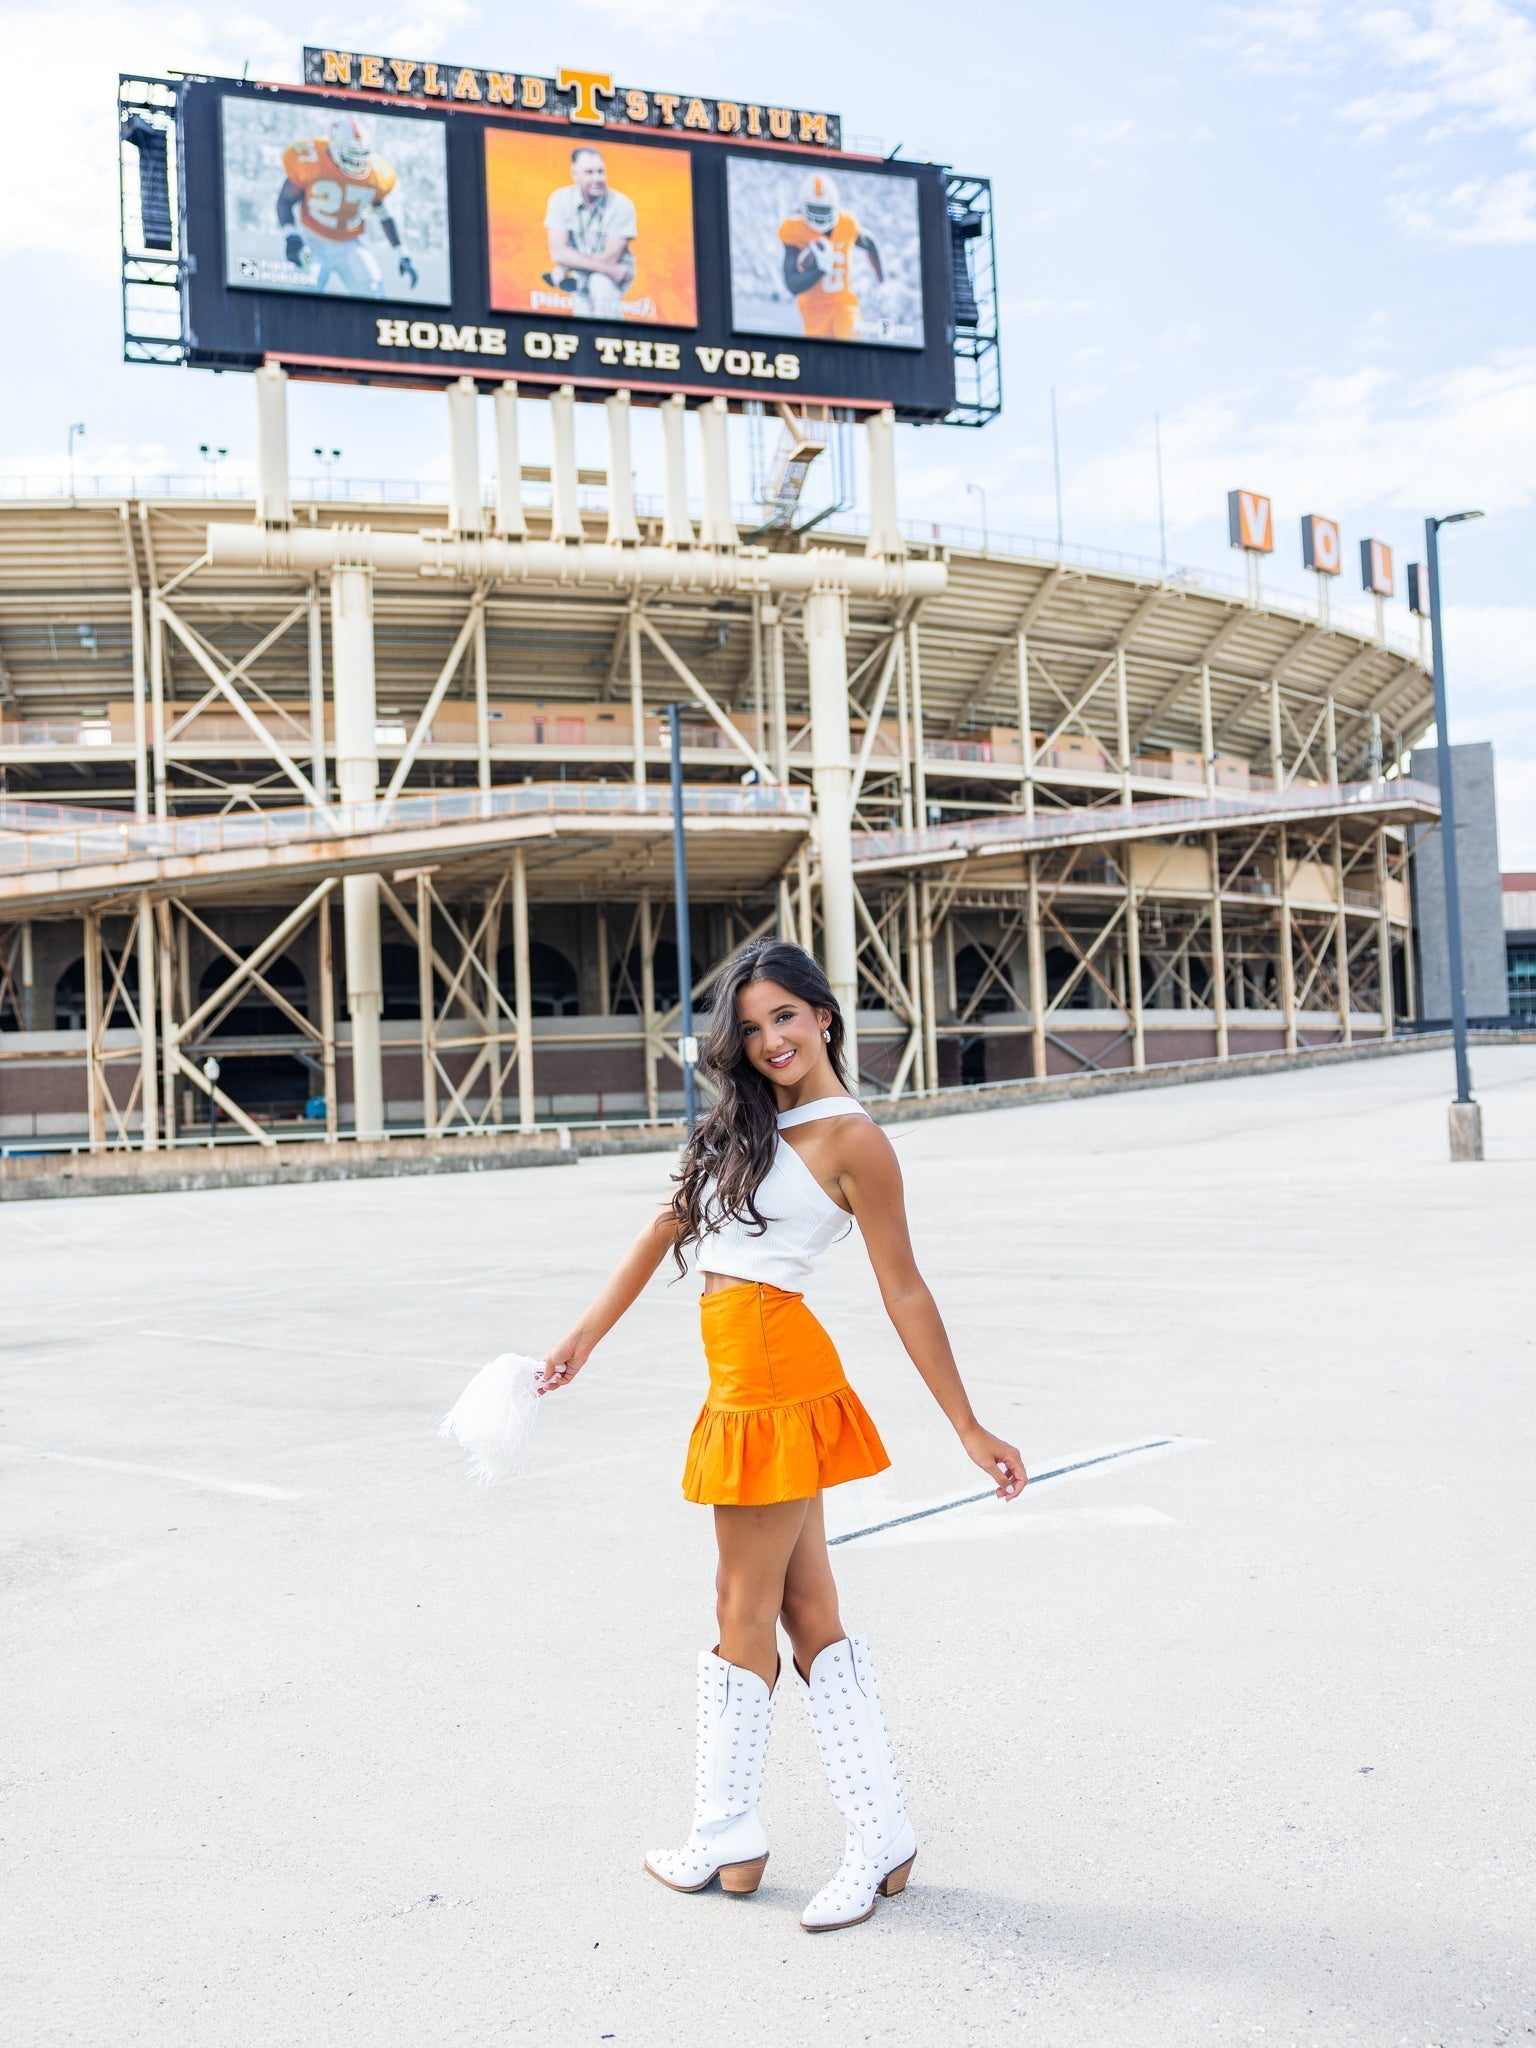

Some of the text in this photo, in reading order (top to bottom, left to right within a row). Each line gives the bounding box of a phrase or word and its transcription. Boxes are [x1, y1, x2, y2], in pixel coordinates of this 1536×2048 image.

[323, 51, 828, 143] NEYLAND T STADIUM
[308, 180, 377, 229] 27
[376, 319, 800, 380] HOME OF THE VOLS
